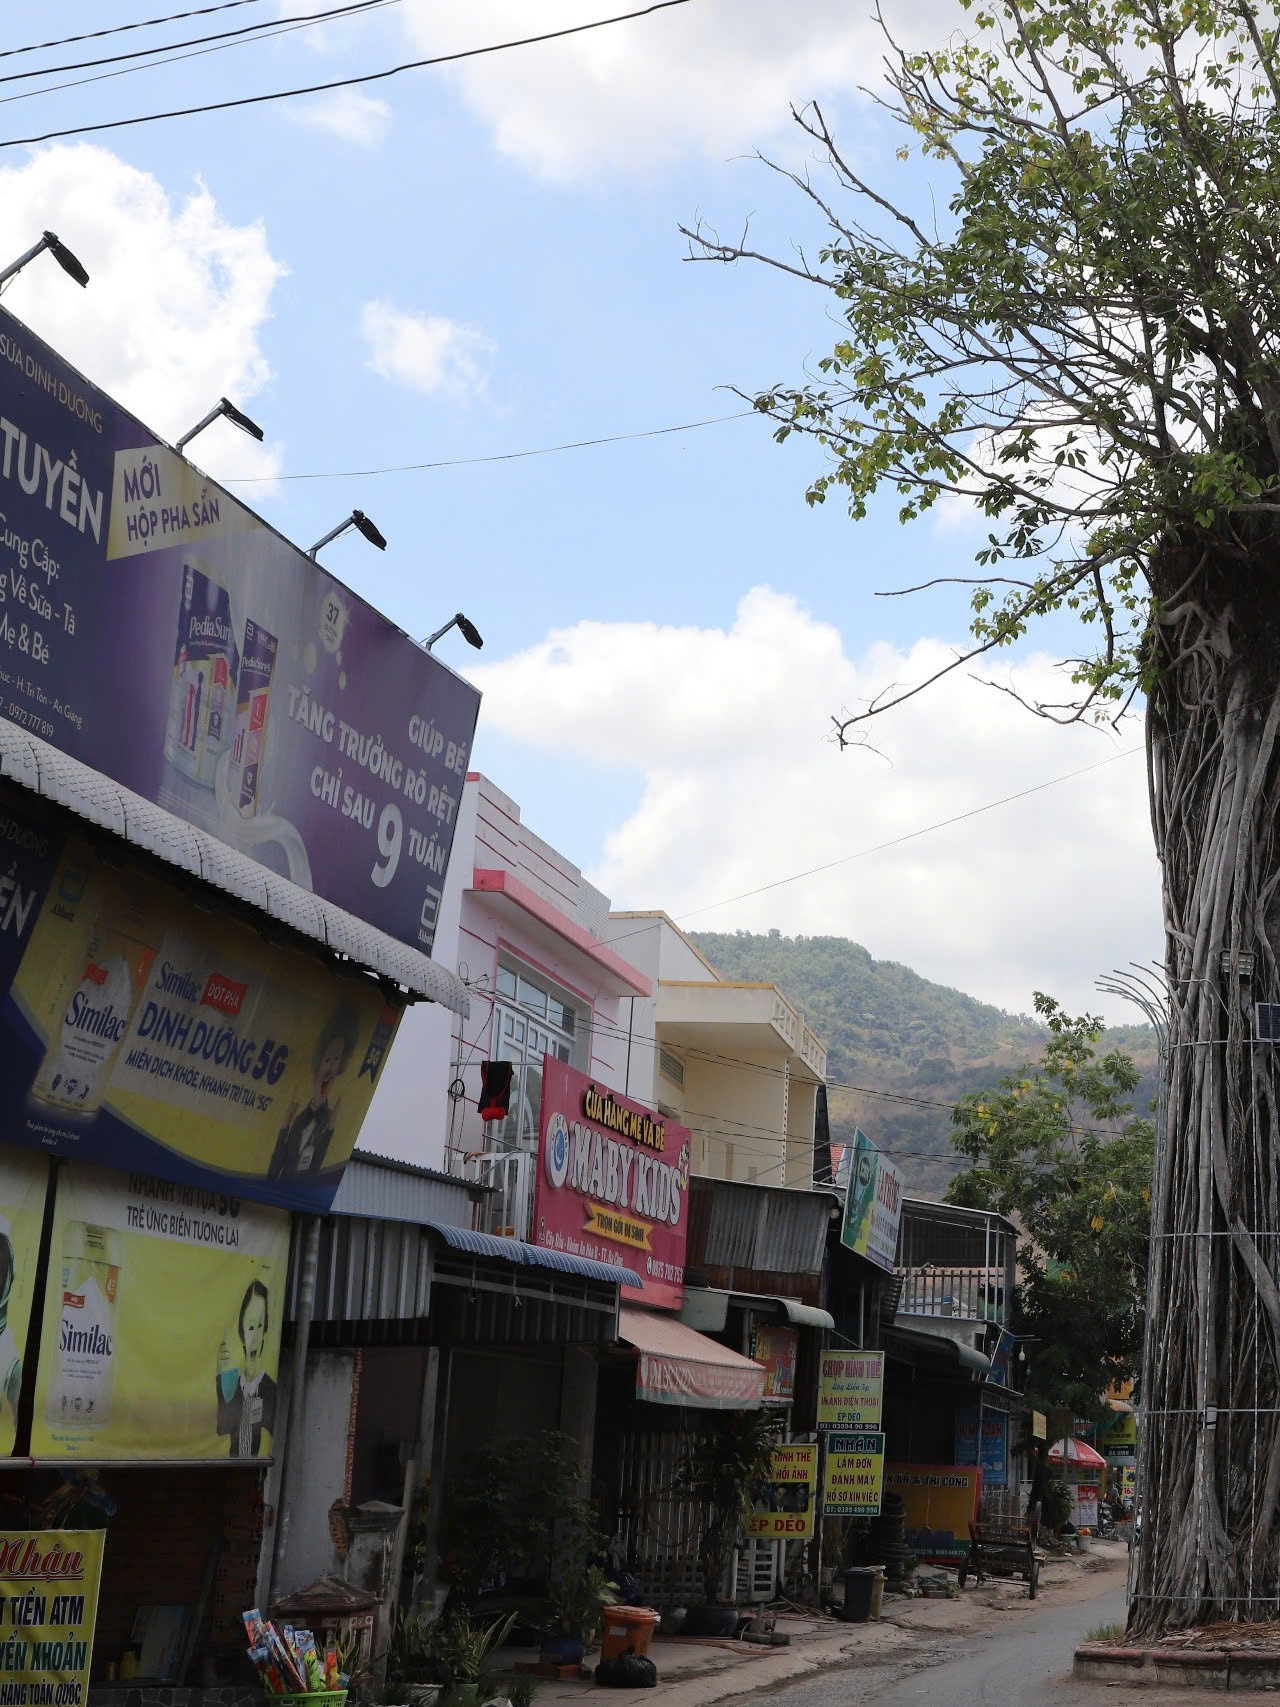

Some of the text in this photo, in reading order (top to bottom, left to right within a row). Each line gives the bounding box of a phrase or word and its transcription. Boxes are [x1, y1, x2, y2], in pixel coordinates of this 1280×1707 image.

[25, 354, 57, 397] DINH
[0, 416, 104, 545] TUYỀN
[123, 456, 162, 503] MỚI
[127, 488, 220, 546] HỘP PHA SẴN
[31, 538, 60, 585] Cấp:
[10, 567, 28, 603] Về
[28, 583, 52, 620] Sữa
[63, 602, 76, 635] Tã
[327, 601, 340, 625] 37
[31, 630, 49, 665] Bé
[287, 683, 458, 827] TĂNG TRƯỞNG RÕ RỆT
[407, 713, 467, 777] GIÚP BÉ
[310, 765, 446, 889] CHỈ SAU 9 TUẦN
[156, 961, 201, 1004] Similac
[64, 990, 127, 1043] Similac
[137, 1001, 289, 1086] DINH DƯỠNG 5G
[125, 1046, 151, 1071] MIỄN
[150, 1057, 176, 1079] DỊCH
[199, 1075, 233, 1098] NHANH
[603, 1094, 630, 1137] HÀNG
[570, 1121, 634, 1209] MABY
[635, 1151, 682, 1227] KIDS
[127, 1203, 145, 1229] TRẺ
[146, 1206, 168, 1234] ỨNG
[192, 1218, 225, 1244] TƯƠNG
[225, 1226, 239, 1247] LAI
[59, 1319, 113, 1357] Similac
[796, 1448, 811, 1462] THẺ
[834, 1435, 877, 1454] NHẬN
[837, 1455, 854, 1469] LÀM
[791, 1465, 808, 1480] ẢNH
[831, 1471, 876, 1485] ĐÁNH MÁY
[826, 1487, 837, 1502] HỒ
[848, 1490, 860, 1502] XIN
[861, 1489, 879, 1504] VIỆC
[774, 1514, 806, 1532] DẺO
[0, 1537, 84, 1582] Nhận
[10, 1586, 47, 1626] TIỀN
[49, 1595, 85, 1626] ATM
[29, 1678, 53, 1706] TOÀN
[55, 1675, 82, 1706] QUỐC
